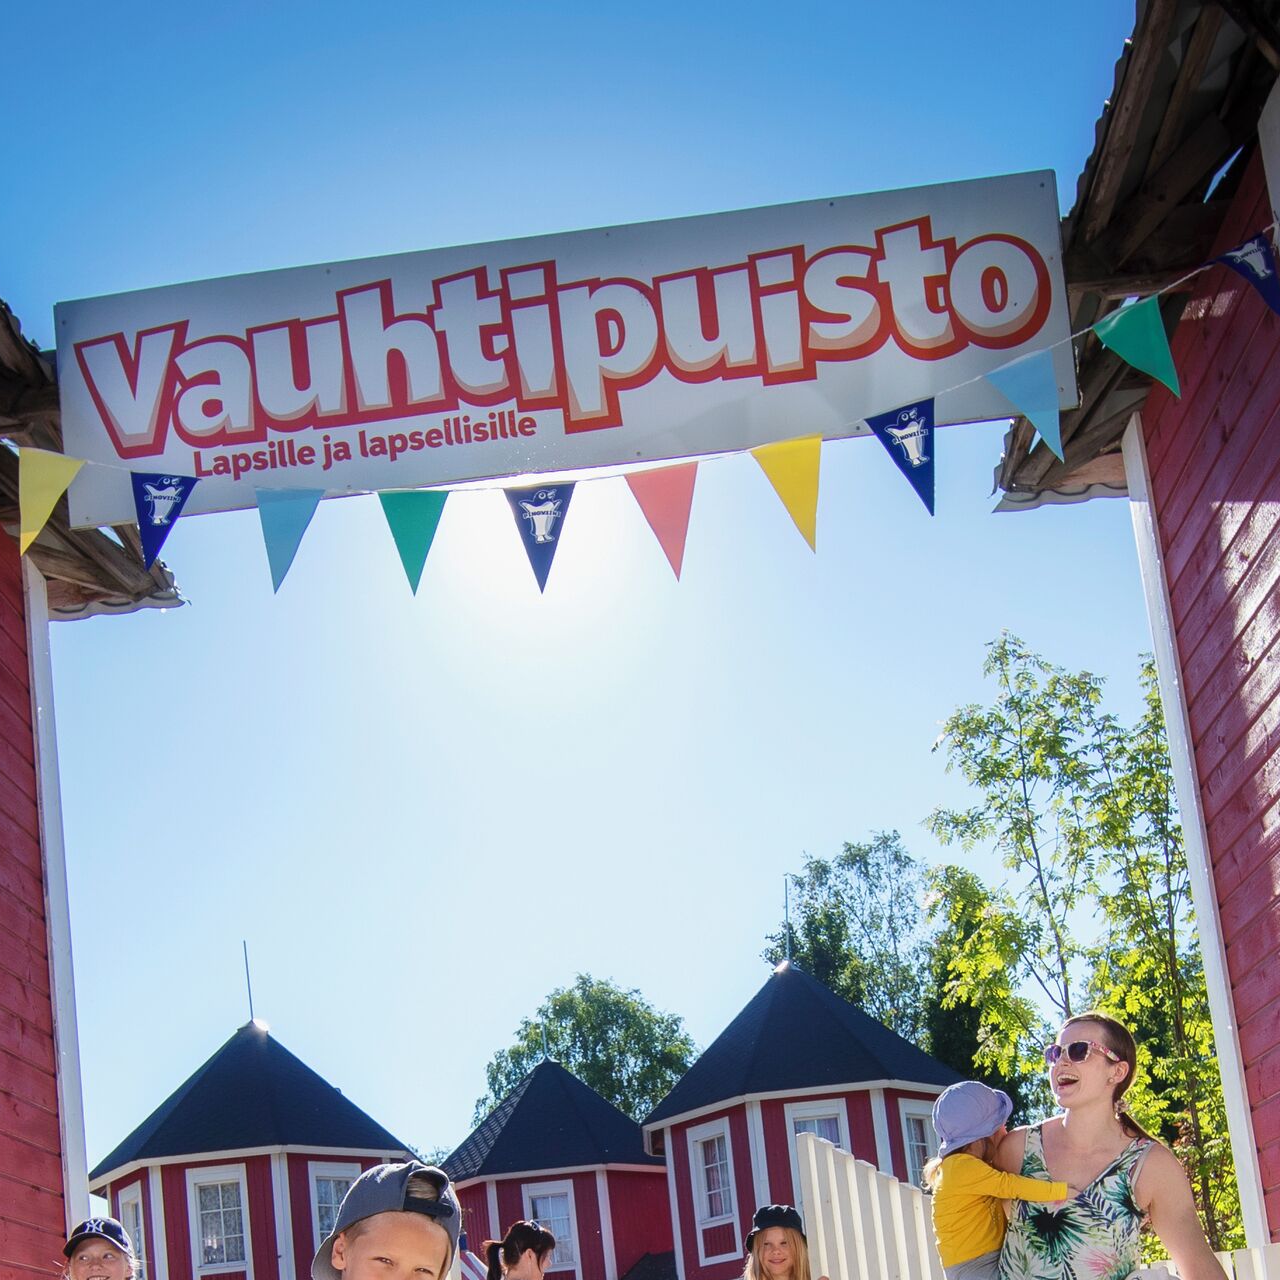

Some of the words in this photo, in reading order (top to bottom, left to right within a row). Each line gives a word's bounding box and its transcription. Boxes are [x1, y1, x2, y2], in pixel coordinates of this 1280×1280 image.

[73, 215, 1051, 458] Vauhtipuisto
[194, 437, 315, 480] Lapsille
[322, 435, 352, 470] ja
[359, 411, 537, 461] lapsellisille
